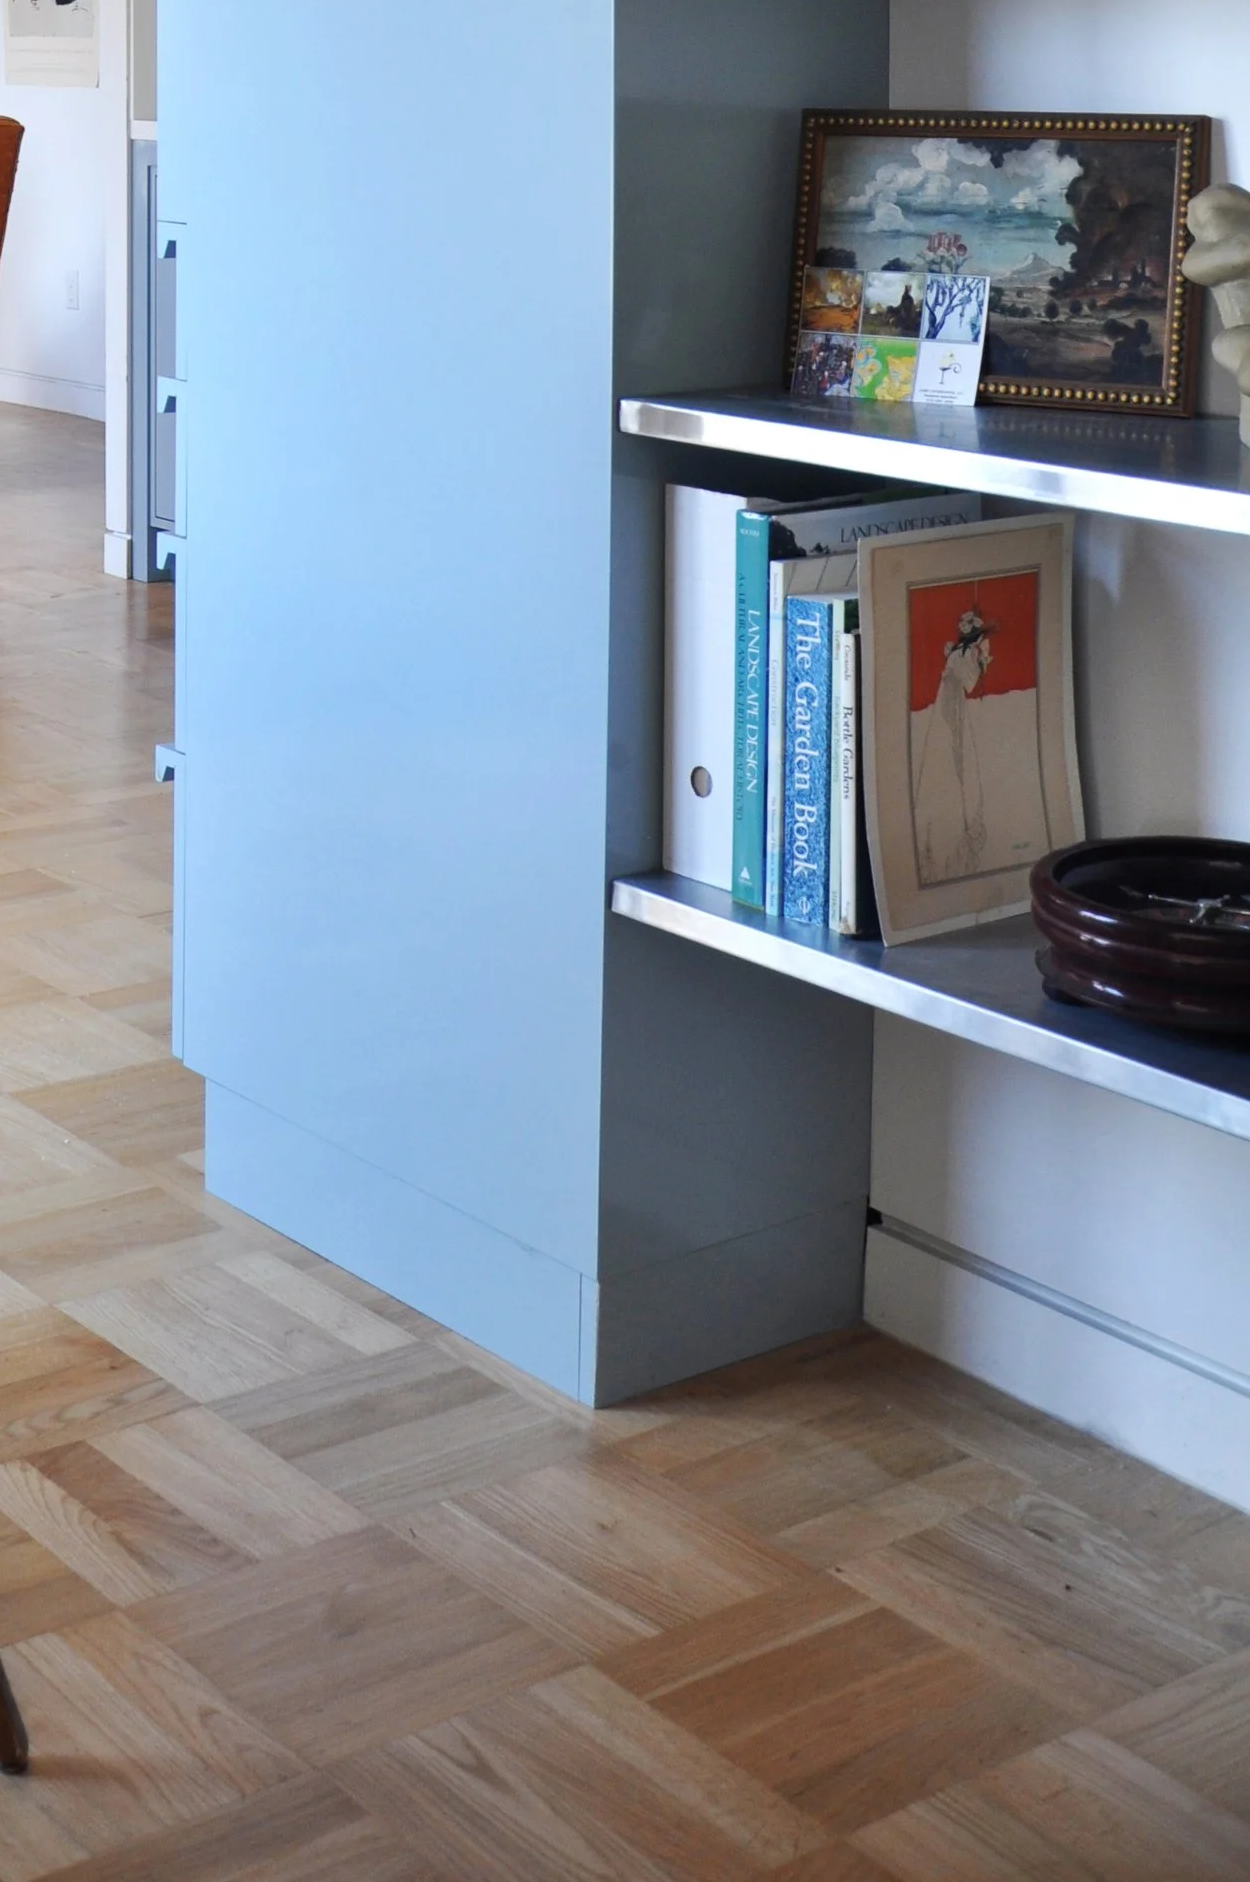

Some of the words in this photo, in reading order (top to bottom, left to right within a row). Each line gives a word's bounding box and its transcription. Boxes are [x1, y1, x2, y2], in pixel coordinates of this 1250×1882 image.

[840, 516, 917, 543] LANDSCAPE
[920, 512, 968, 530] DESIGN
[746, 609, 760, 719] LANDSCAPE
[796, 611, 821, 670] The
[795, 682, 819, 790] Garden
[843, 706, 854, 743] Bottle
[746, 723, 759, 793] DESIGN
[842, 748, 853, 800] Gardens
[792, 801, 817, 878] Book
